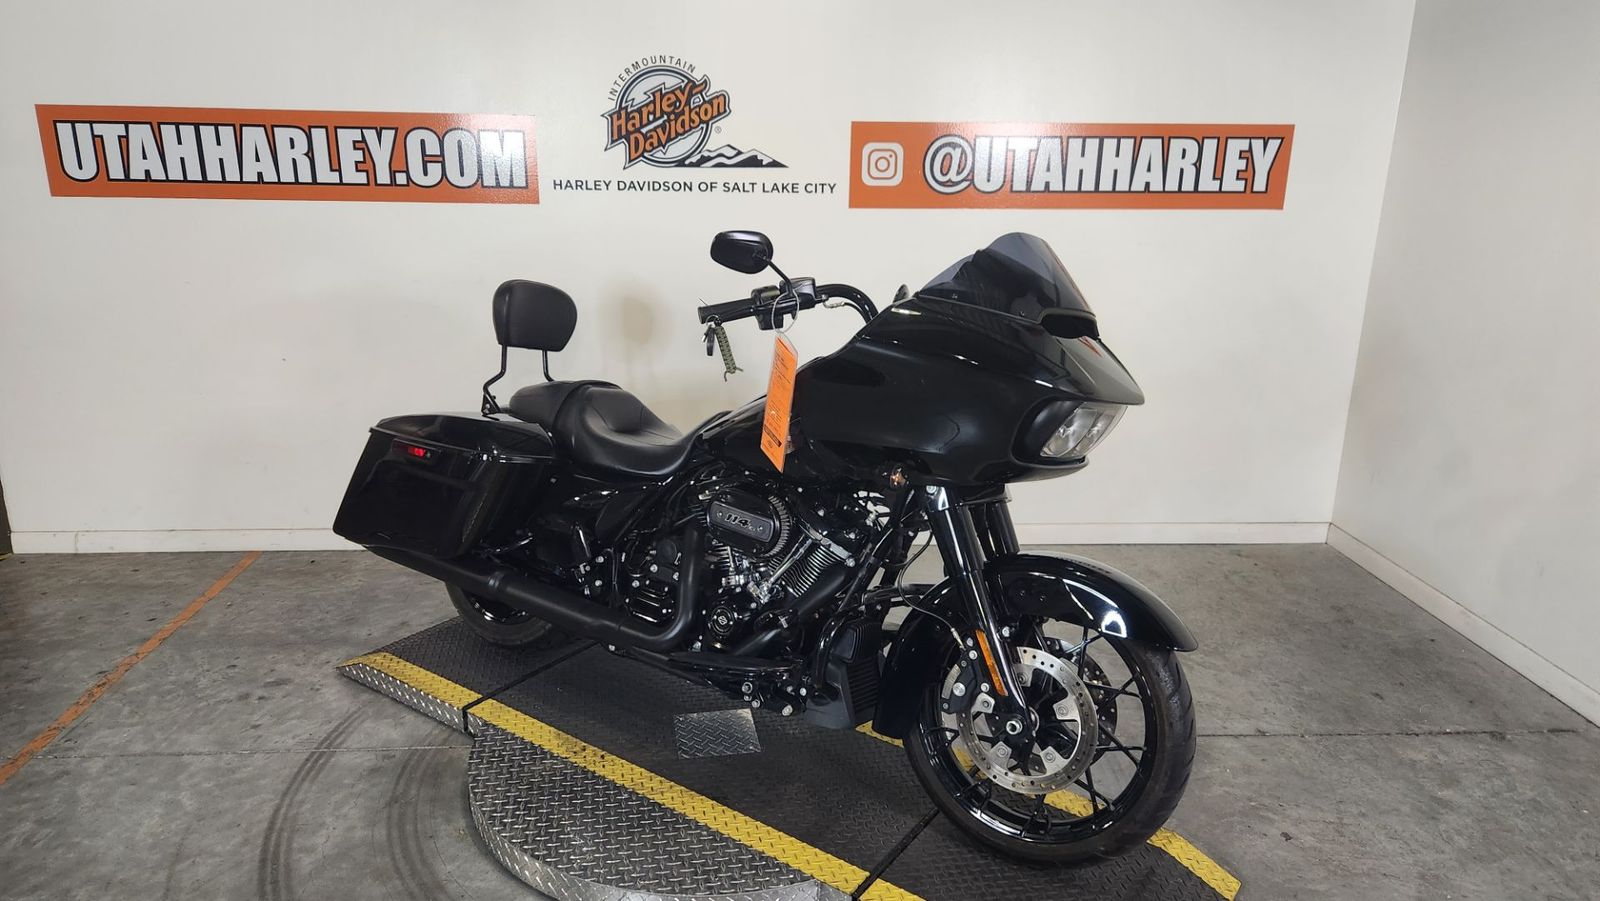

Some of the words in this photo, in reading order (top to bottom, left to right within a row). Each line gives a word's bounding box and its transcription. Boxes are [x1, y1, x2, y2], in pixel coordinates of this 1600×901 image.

[607, 55, 697, 101] INTERMOUNTAIN
[53, 119, 527, 189] UTAHHARLEY.COM
[628, 94, 729, 162] Davidson
[552, 179, 612, 191] HARLEY
[616, 180, 693, 192] DAVIDSON
[698, 181, 718, 193] OF
[722, 182, 757, 193] SALT
[762, 182, 800, 194] LAKE
[804, 182, 837, 194] CITY
[922, 134, 1285, 195] @UTAHHARLEY
[725, 512, 751, 529] 114
